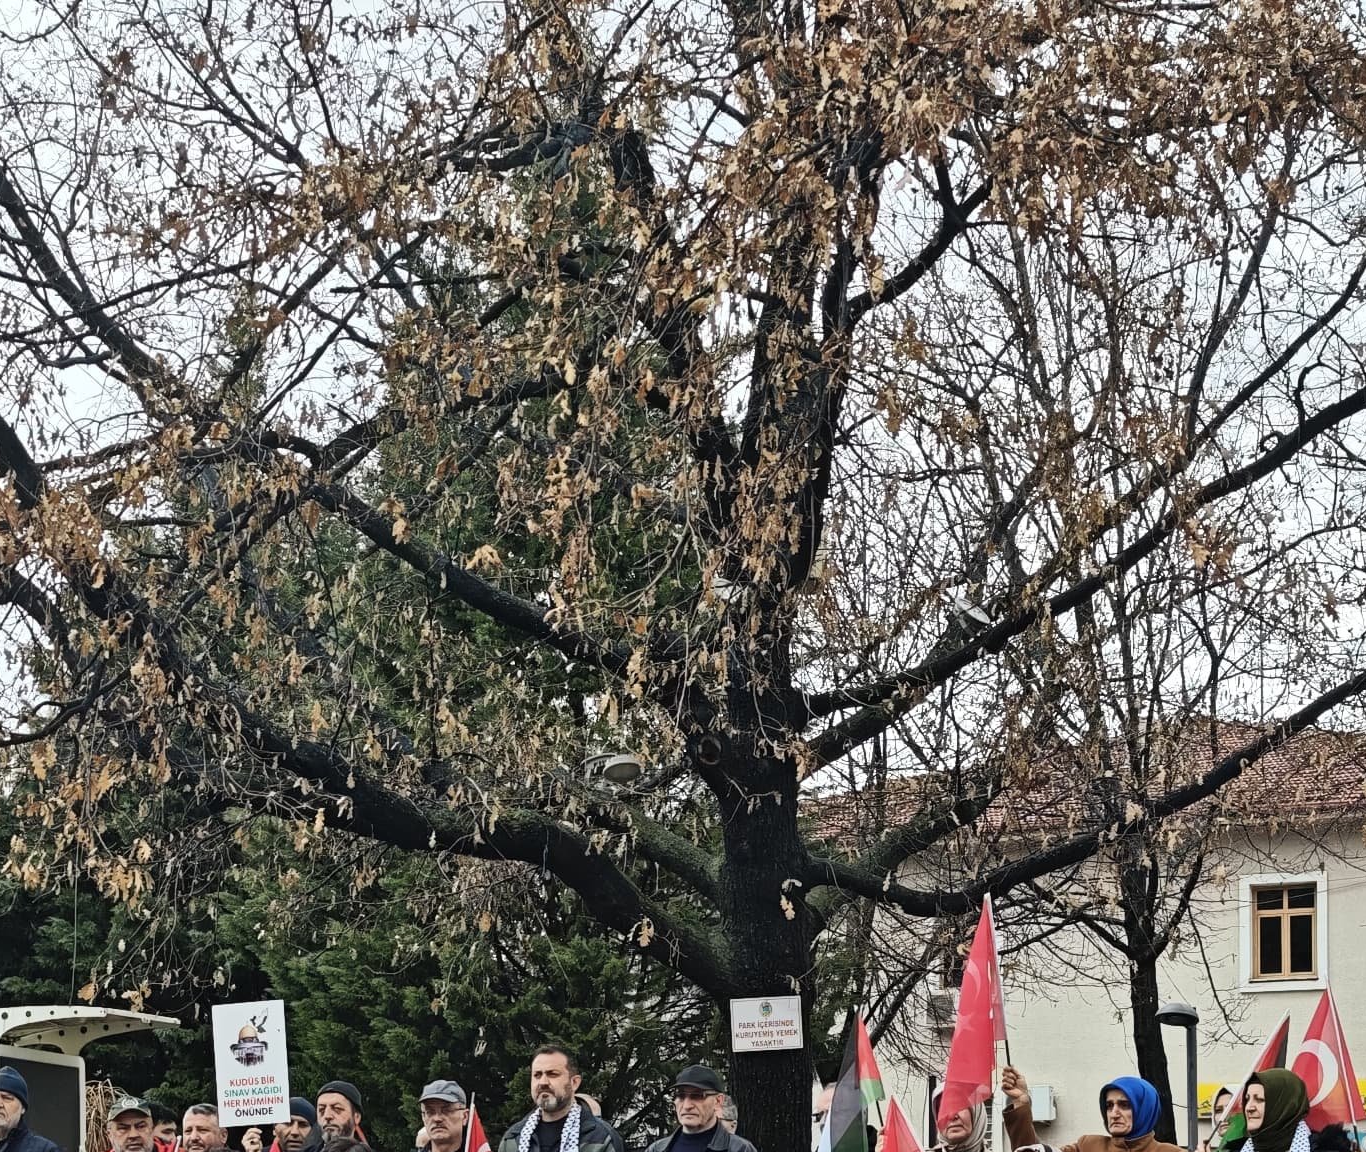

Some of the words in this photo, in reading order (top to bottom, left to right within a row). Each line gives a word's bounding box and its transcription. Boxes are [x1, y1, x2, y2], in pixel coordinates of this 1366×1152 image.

[229, 1075, 260, 1087] KUDÜS
[260, 1074, 275, 1085] BİR
[224, 1087, 250, 1098] SINAV
[223, 1100, 241, 1108] HER
[234, 1106, 274, 1118] ÖNÜNDE
